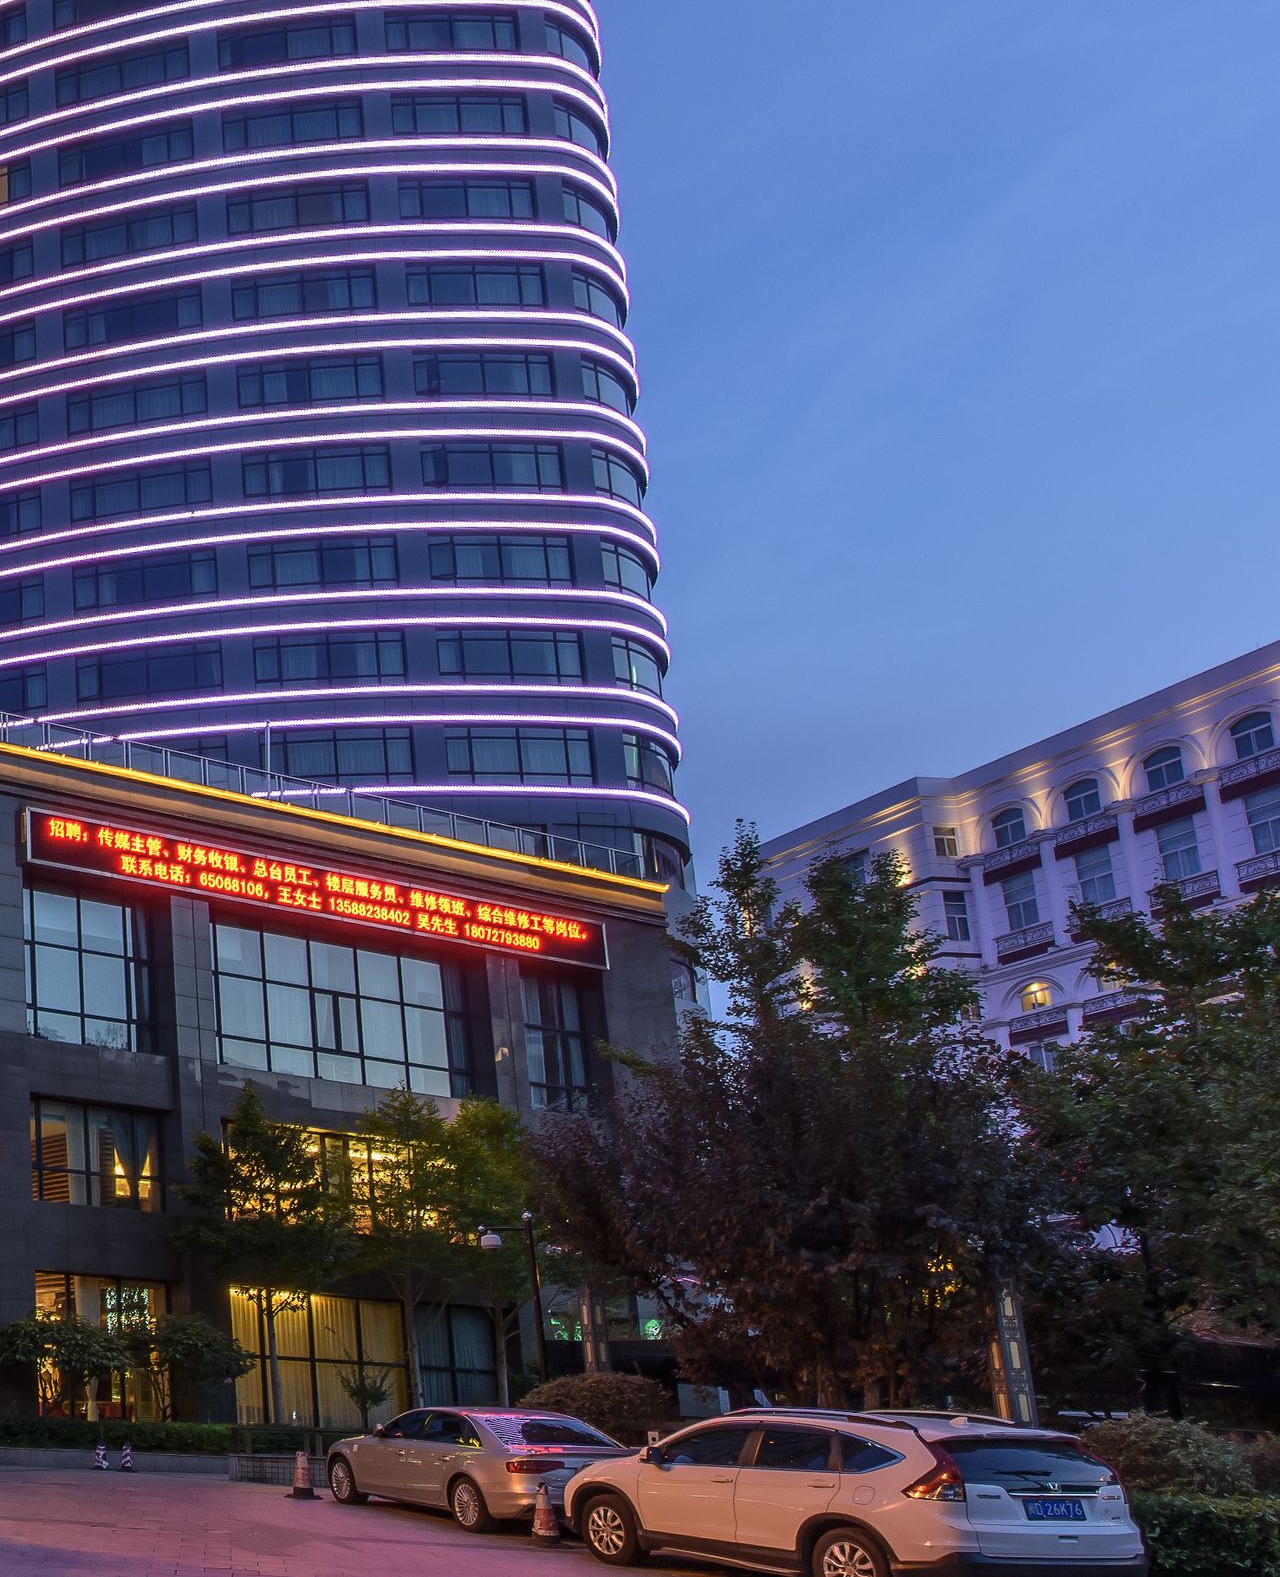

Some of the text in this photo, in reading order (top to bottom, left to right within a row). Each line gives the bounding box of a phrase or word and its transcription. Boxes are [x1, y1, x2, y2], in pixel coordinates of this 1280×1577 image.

[328, 897, 411, 926] 13588238402
[417, 912, 458, 935] 吴先生
[464, 923, 541, 950] 18072793880
